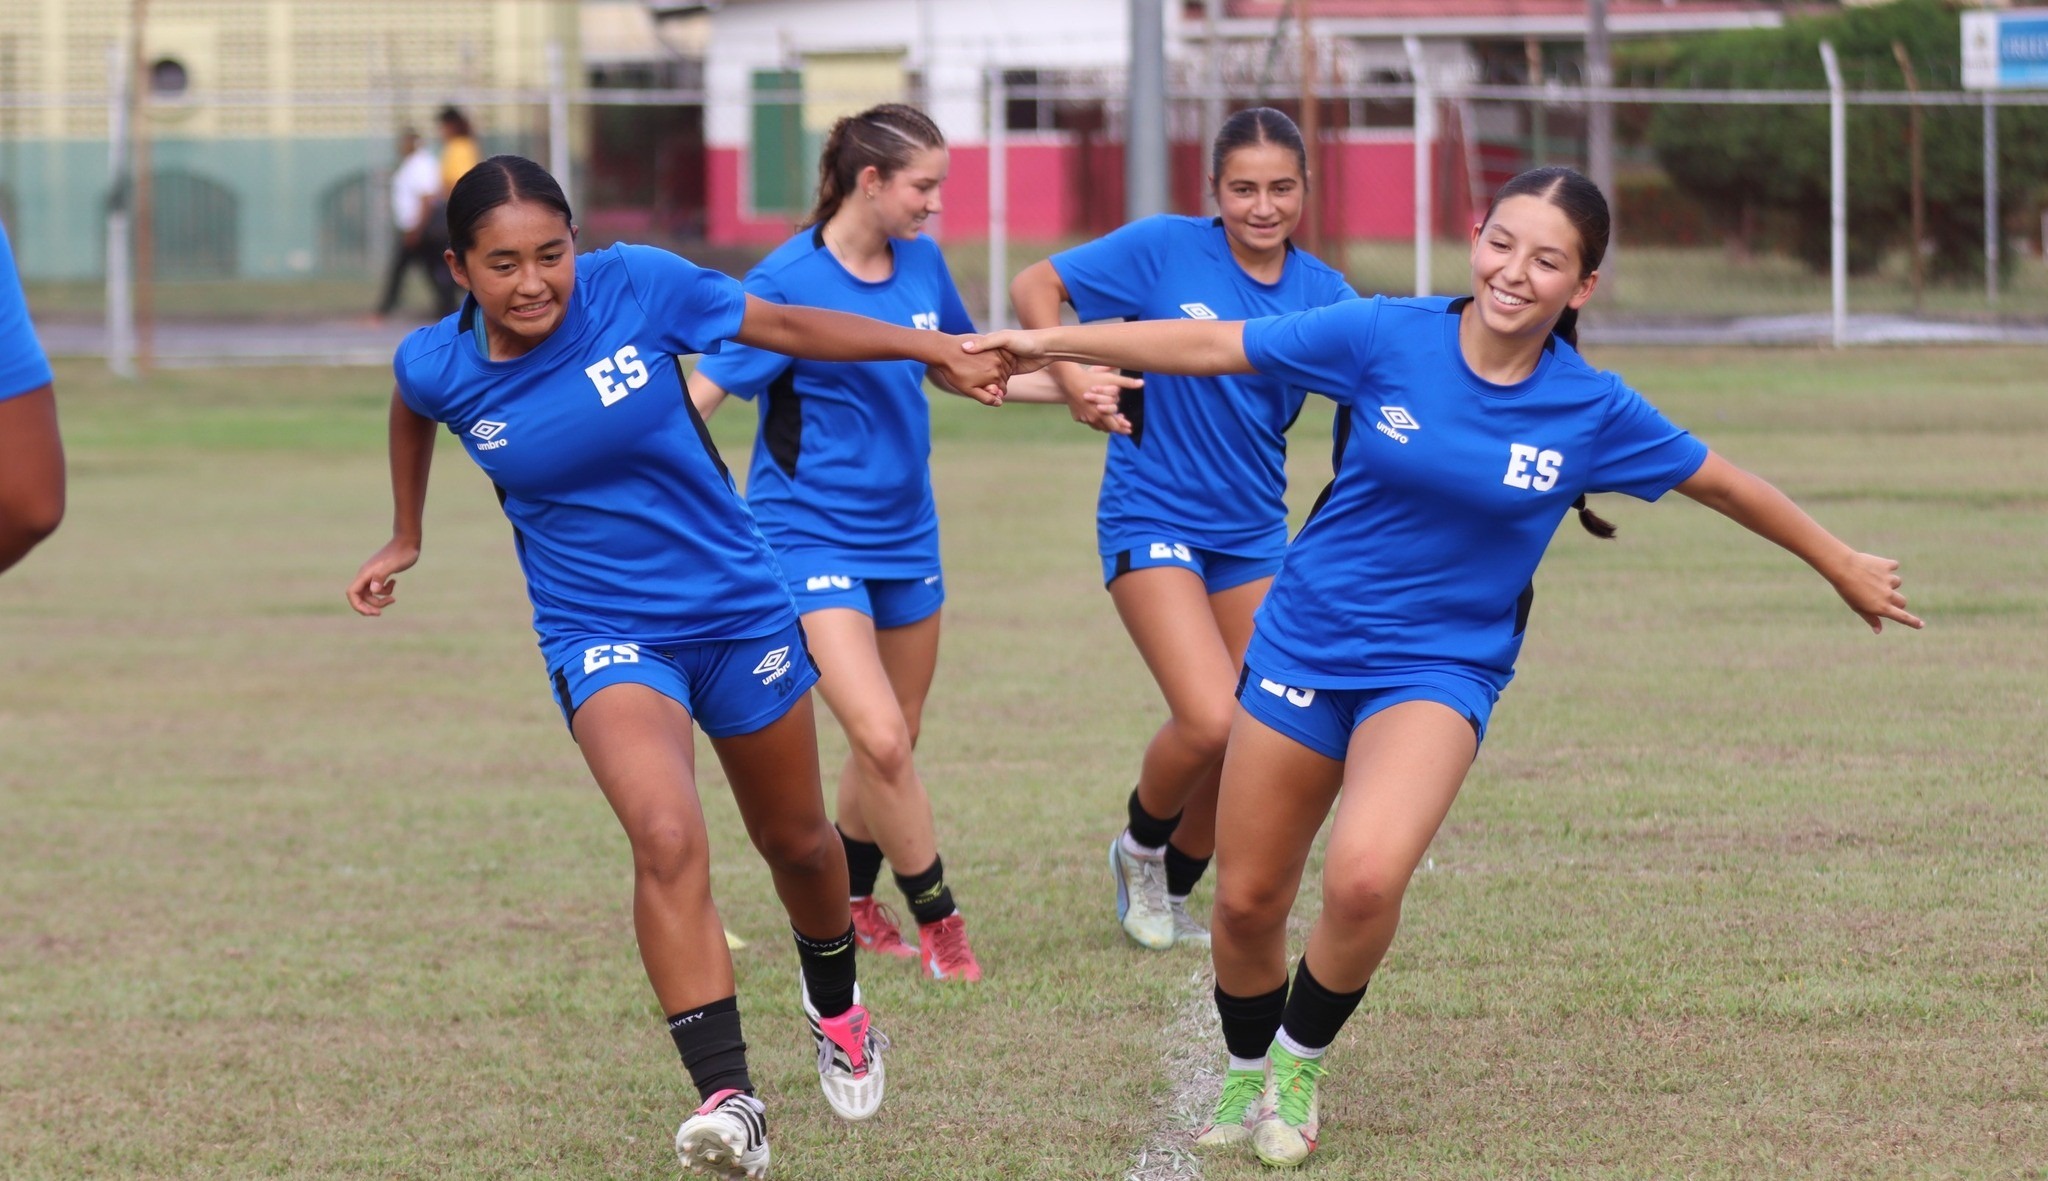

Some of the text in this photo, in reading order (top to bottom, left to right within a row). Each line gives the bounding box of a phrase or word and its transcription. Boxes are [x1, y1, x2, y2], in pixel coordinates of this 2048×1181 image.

[585, 345, 649, 407] ES
[477, 437, 508, 450] umbro
[1376, 420, 1408, 444] umbro
[1503, 443, 1563, 492] ES
[583, 643, 640, 675] ES
[762, 660, 791, 685] umbro
